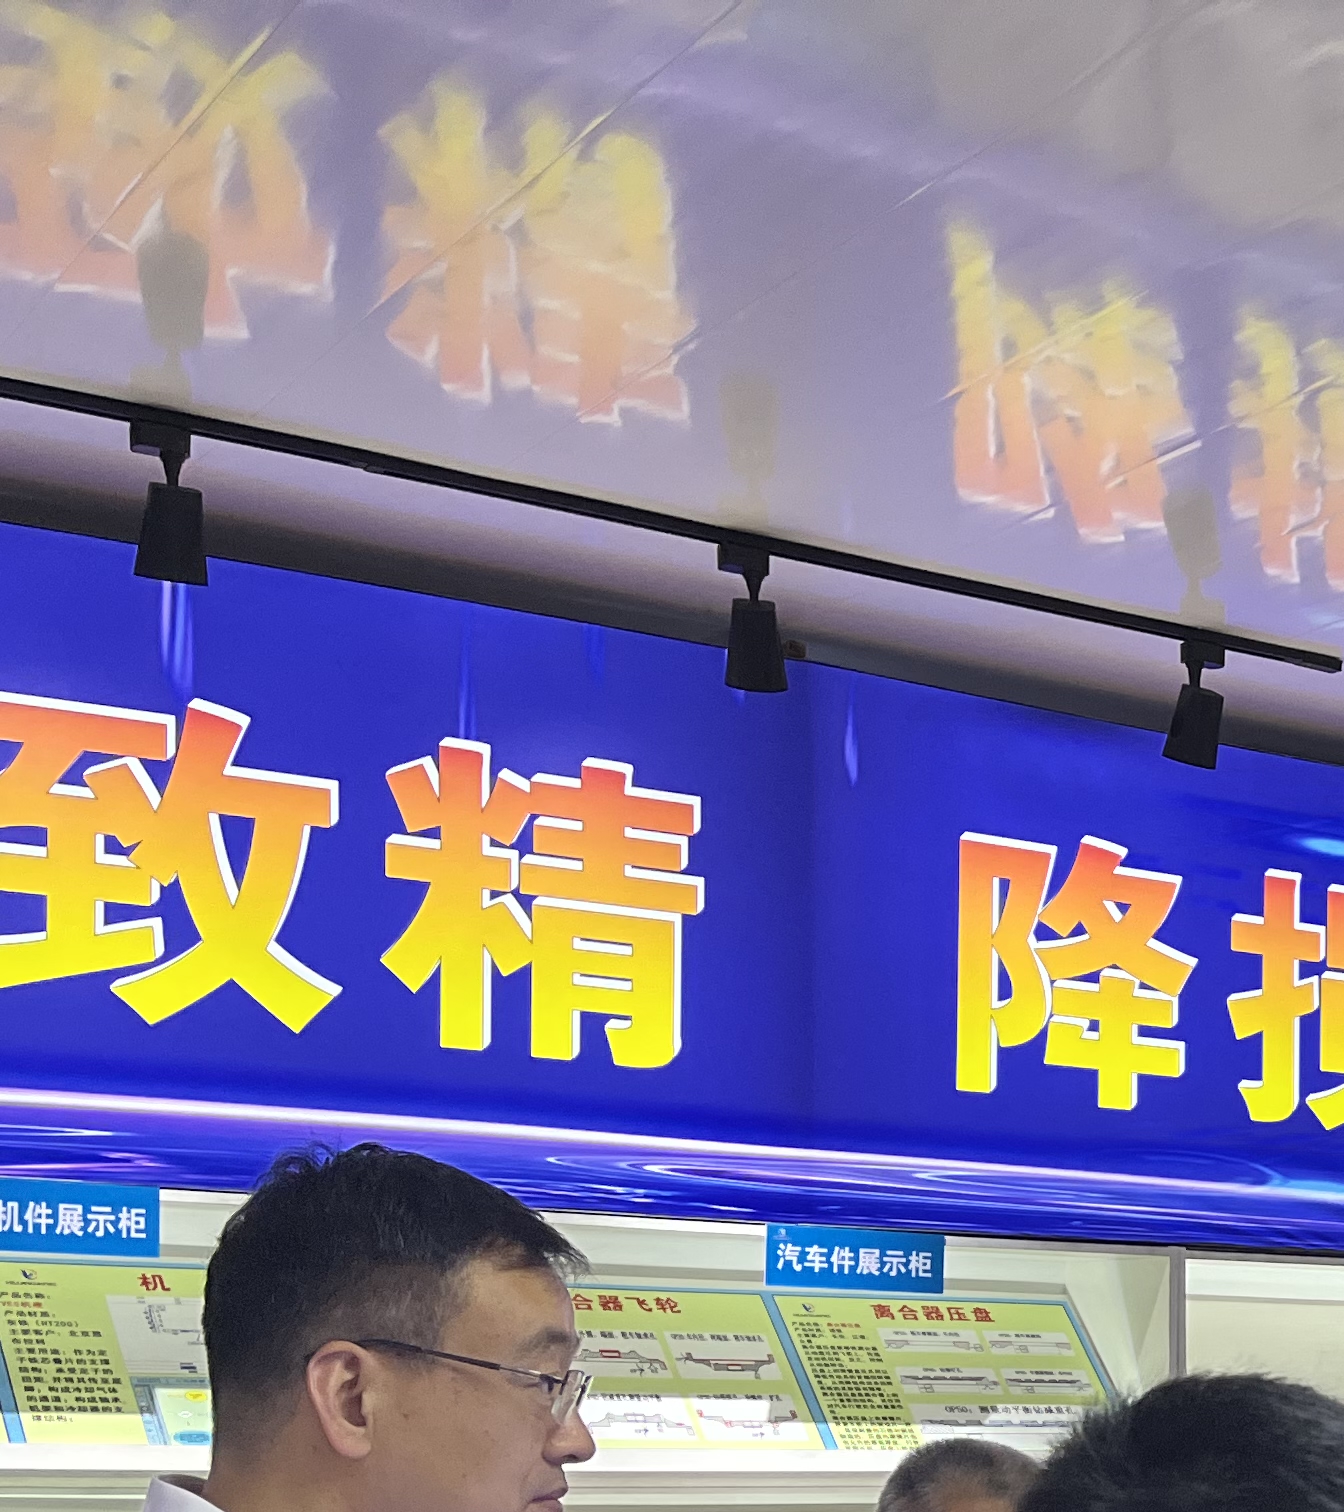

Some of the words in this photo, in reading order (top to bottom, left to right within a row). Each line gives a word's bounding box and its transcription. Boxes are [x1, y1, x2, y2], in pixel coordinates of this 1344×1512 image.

[0, 697, 705, 1068] 致精
[0, 1201, 147, 1239] 机件展示柜
[776, 1243, 932, 1278] 汽车件展示柜
[137, 1273, 171, 1292] 机
[571, 1293, 682, 1314] 合器飞轮
[870, 1303, 997, 1324] 离合器压盘
